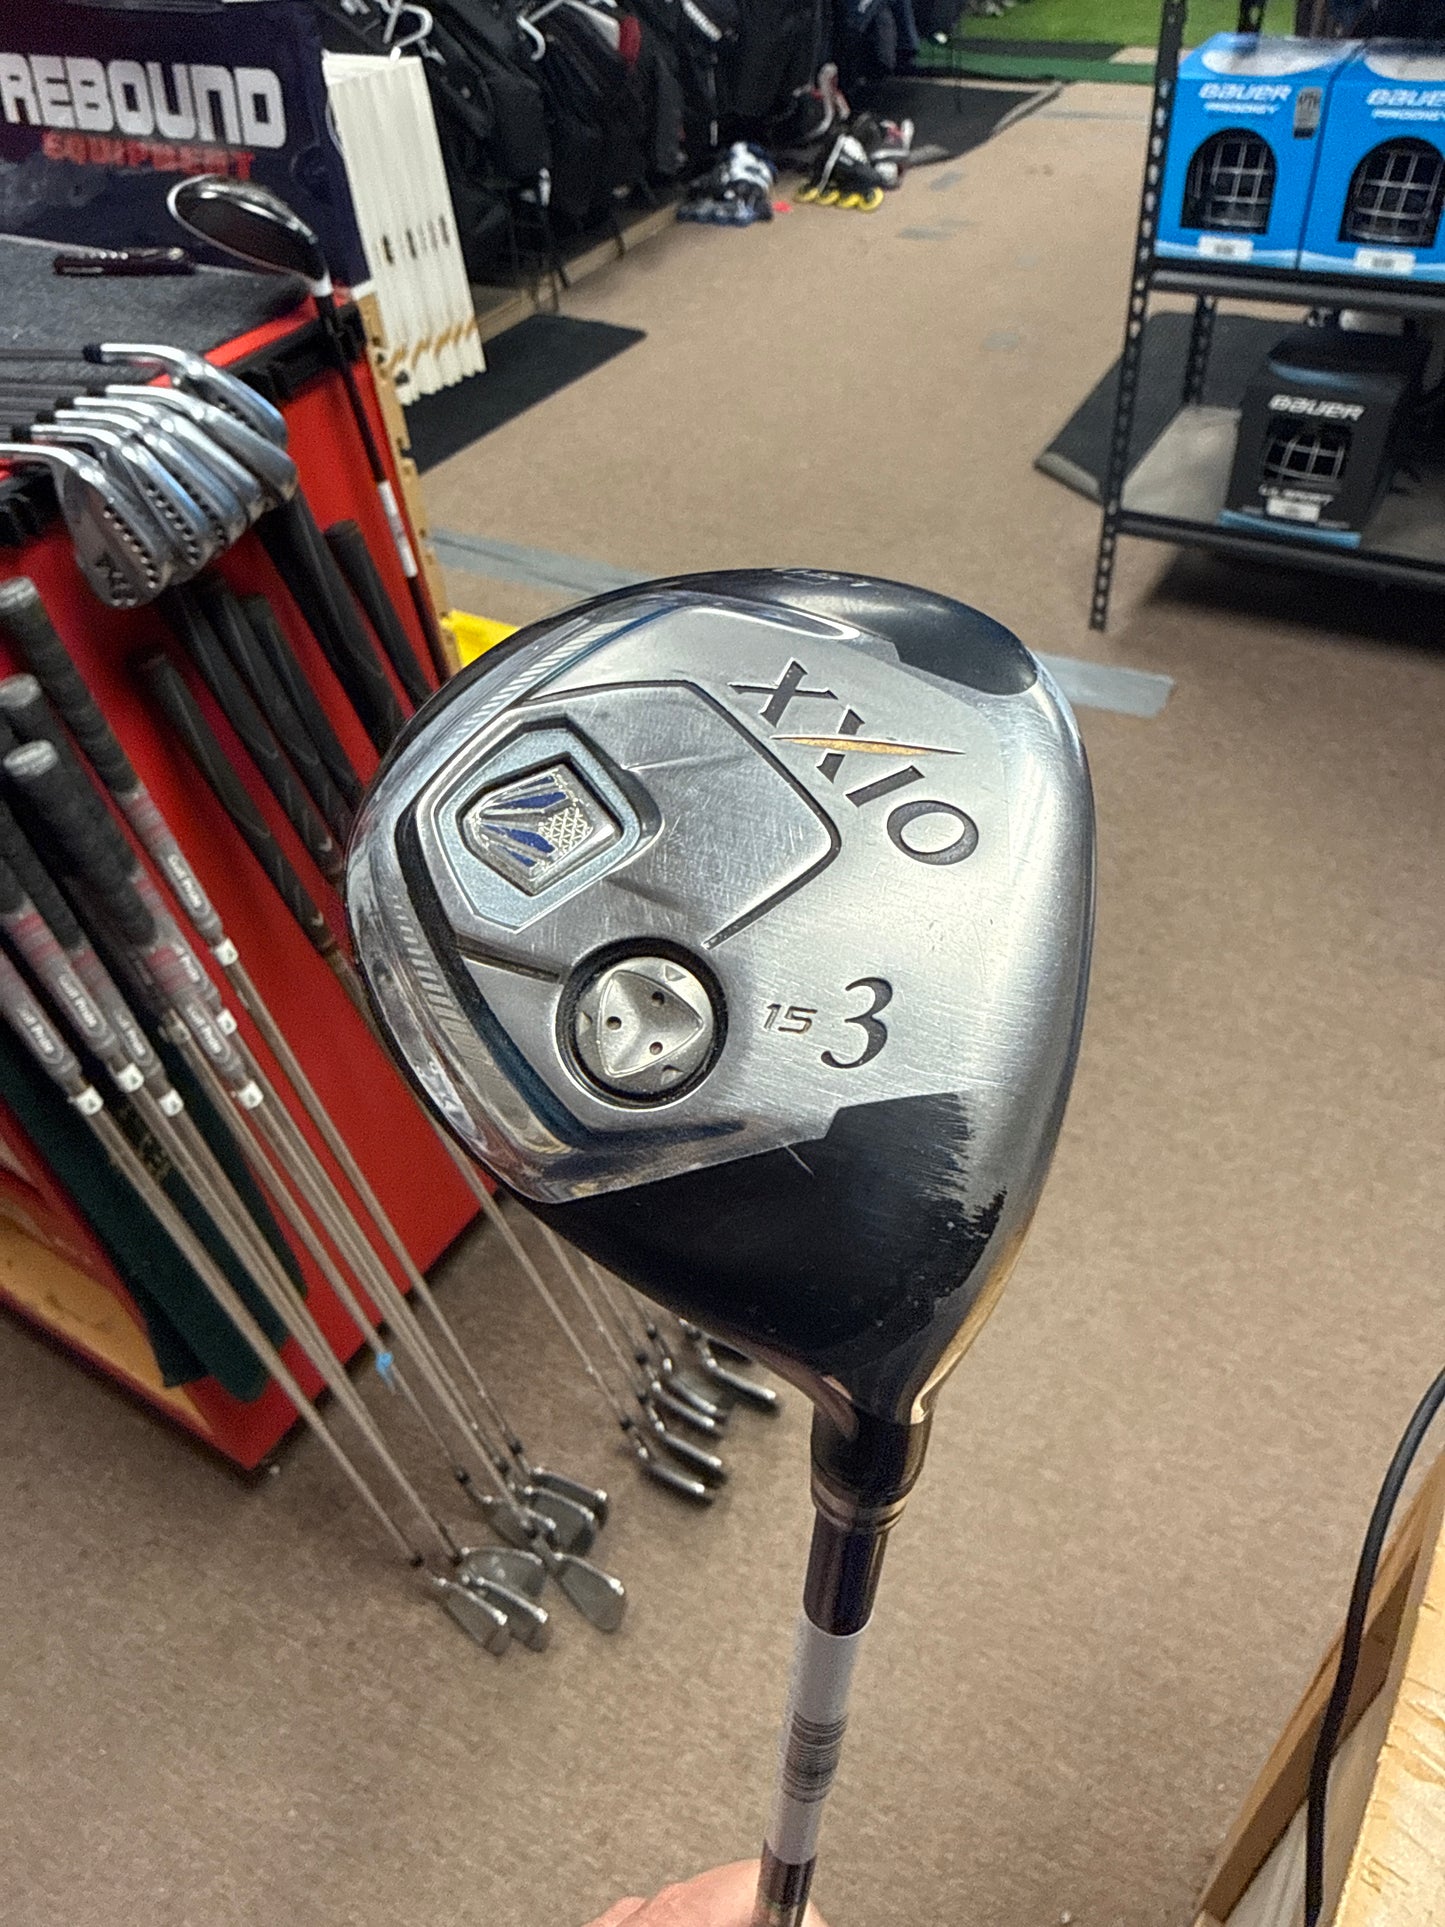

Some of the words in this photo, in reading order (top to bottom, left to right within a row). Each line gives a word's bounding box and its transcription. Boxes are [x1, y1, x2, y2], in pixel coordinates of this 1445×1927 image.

[0, 53, 287, 149] REBOUND
[1199, 82, 1293, 102] BAUER
[1268, 394, 1366, 421] BAUER
[727, 657, 979, 866] XXIO
[764, 1003, 818, 1035] 15
[821, 976, 893, 1069] 3
